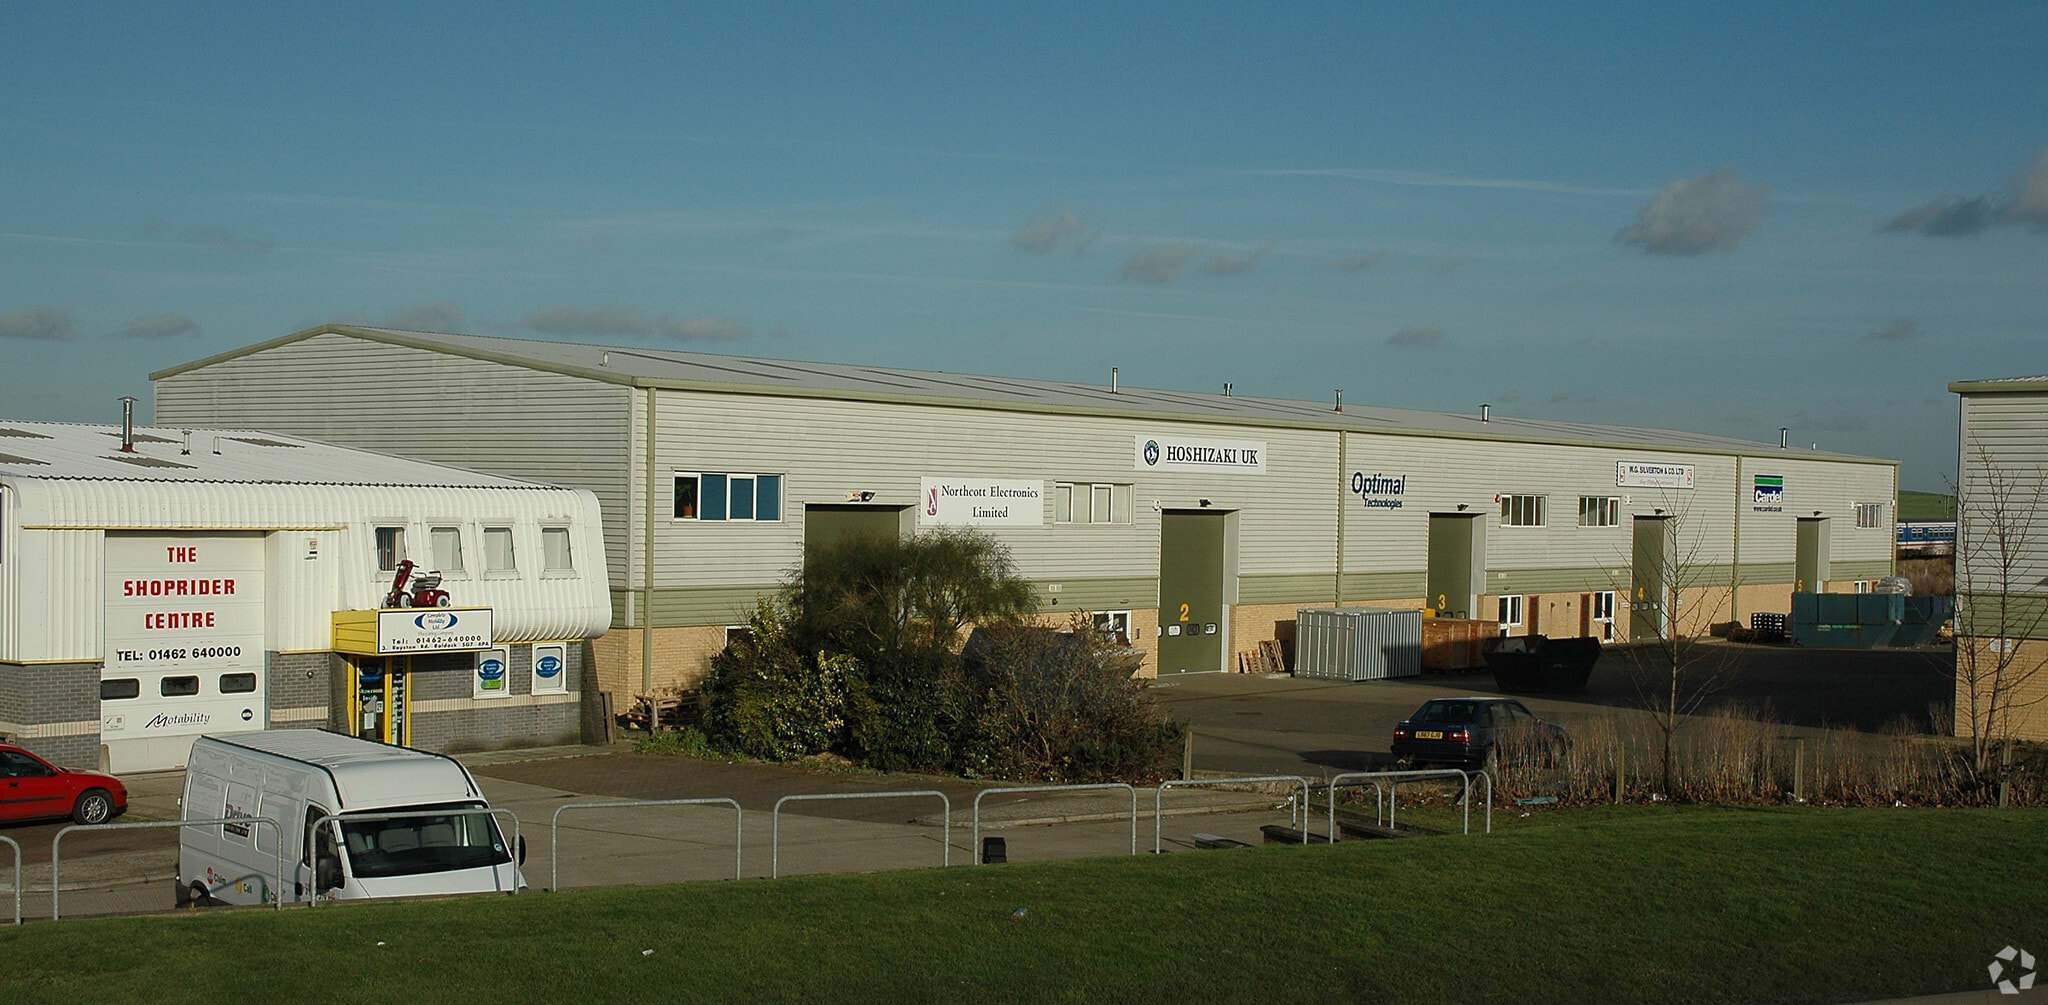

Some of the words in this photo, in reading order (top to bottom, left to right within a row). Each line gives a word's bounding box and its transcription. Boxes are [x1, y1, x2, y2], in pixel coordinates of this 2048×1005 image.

[1166, 445, 1237, 464] HOSHIZAKI
[1241, 449, 1258, 464] UK
[1640, 466, 1663, 475] SILVERTON
[1676, 467, 1685, 475] LTD
[941, 485, 986, 497] Northcott
[990, 485, 1039, 498] Electronics
[1351, 471, 1406, 500] Optimal
[1363, 498, 1403, 510] Technologies
[1755, 490, 1783, 503] Cardel
[972, 506, 1008, 518] Limited
[166, 547, 197, 563] THE
[123, 579, 236, 597] SHOPRIDER
[1637, 587, 1644, 600] 4
[1438, 594, 1446, 610] 3
[145, 611, 215, 629] CENTRE
[1180, 603, 1189, 621] 2
[416, 635, 482, 644] 01462-640000
[117, 650, 143, 662] TEL:
[148, 648, 187, 661] 01462
[192, 646, 241, 659] 640000
[145, 712, 211, 729] Motability
[225, 803, 253, 828] Drive
